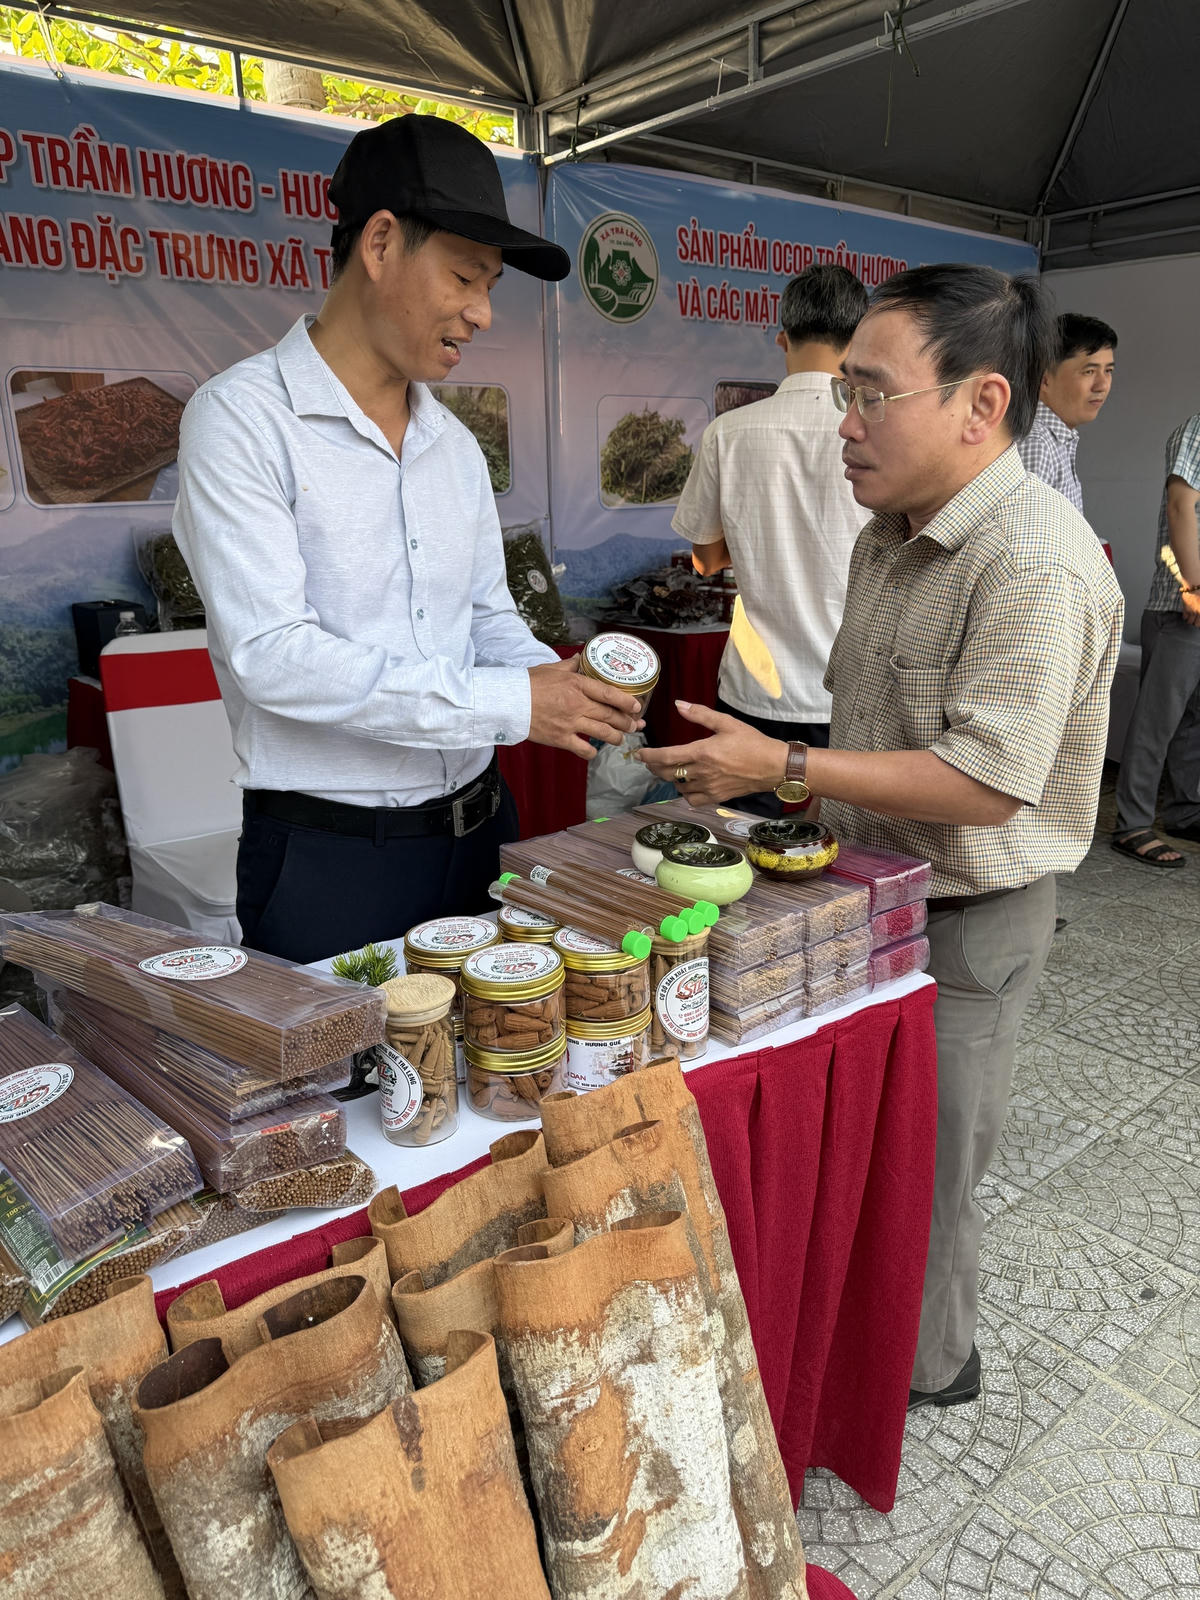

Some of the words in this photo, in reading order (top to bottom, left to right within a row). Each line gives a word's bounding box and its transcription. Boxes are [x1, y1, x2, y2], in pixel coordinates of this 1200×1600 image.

[22, 126, 132, 194] TRẦM
[139, 150, 252, 210] HƯƠNG
[70, 215, 144, 280] ĐẶC
[149, 230, 259, 283] TRƯNG
[265, 237, 310, 288] XÃ
[677, 218, 714, 264] SẢN
[719, 223, 767, 271] PHẨM
[772, 241, 813, 274] OCOP
[677, 277, 702, 318] VÀ
[707, 282, 740, 320] CÁC
[745, 286, 780, 330] MẶT
